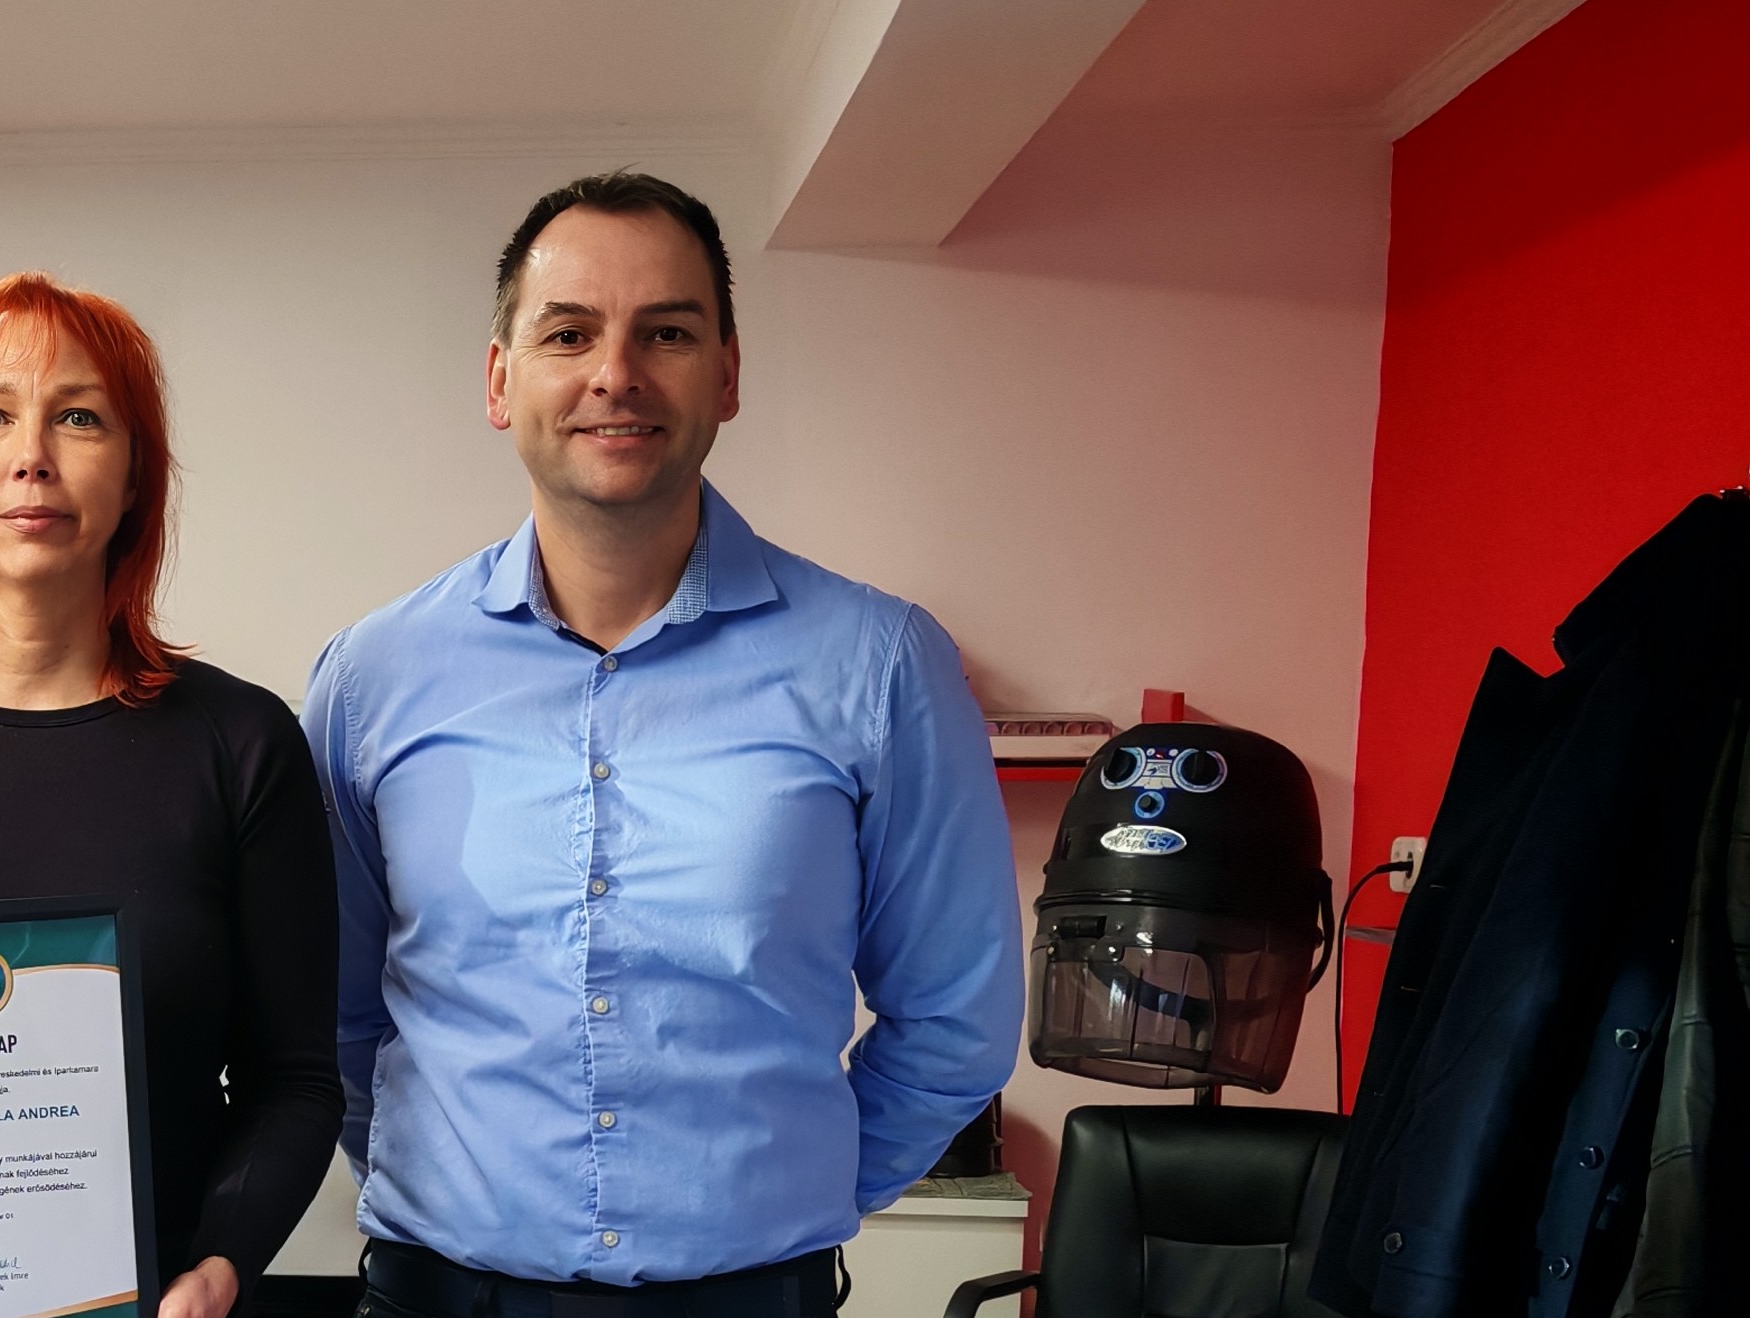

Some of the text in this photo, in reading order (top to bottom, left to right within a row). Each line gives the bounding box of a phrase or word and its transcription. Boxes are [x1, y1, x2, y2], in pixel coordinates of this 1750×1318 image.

[42, 1067, 52, 1075] és
[54, 1065, 99, 1076] Iparkamara
[18, 1105, 80, 1120] ANDREA
[5, 1152, 53, 1163] munkájával
[54, 1149, 97, 1160] hozzájárul
[10, 1272, 29, 1280] Imre
